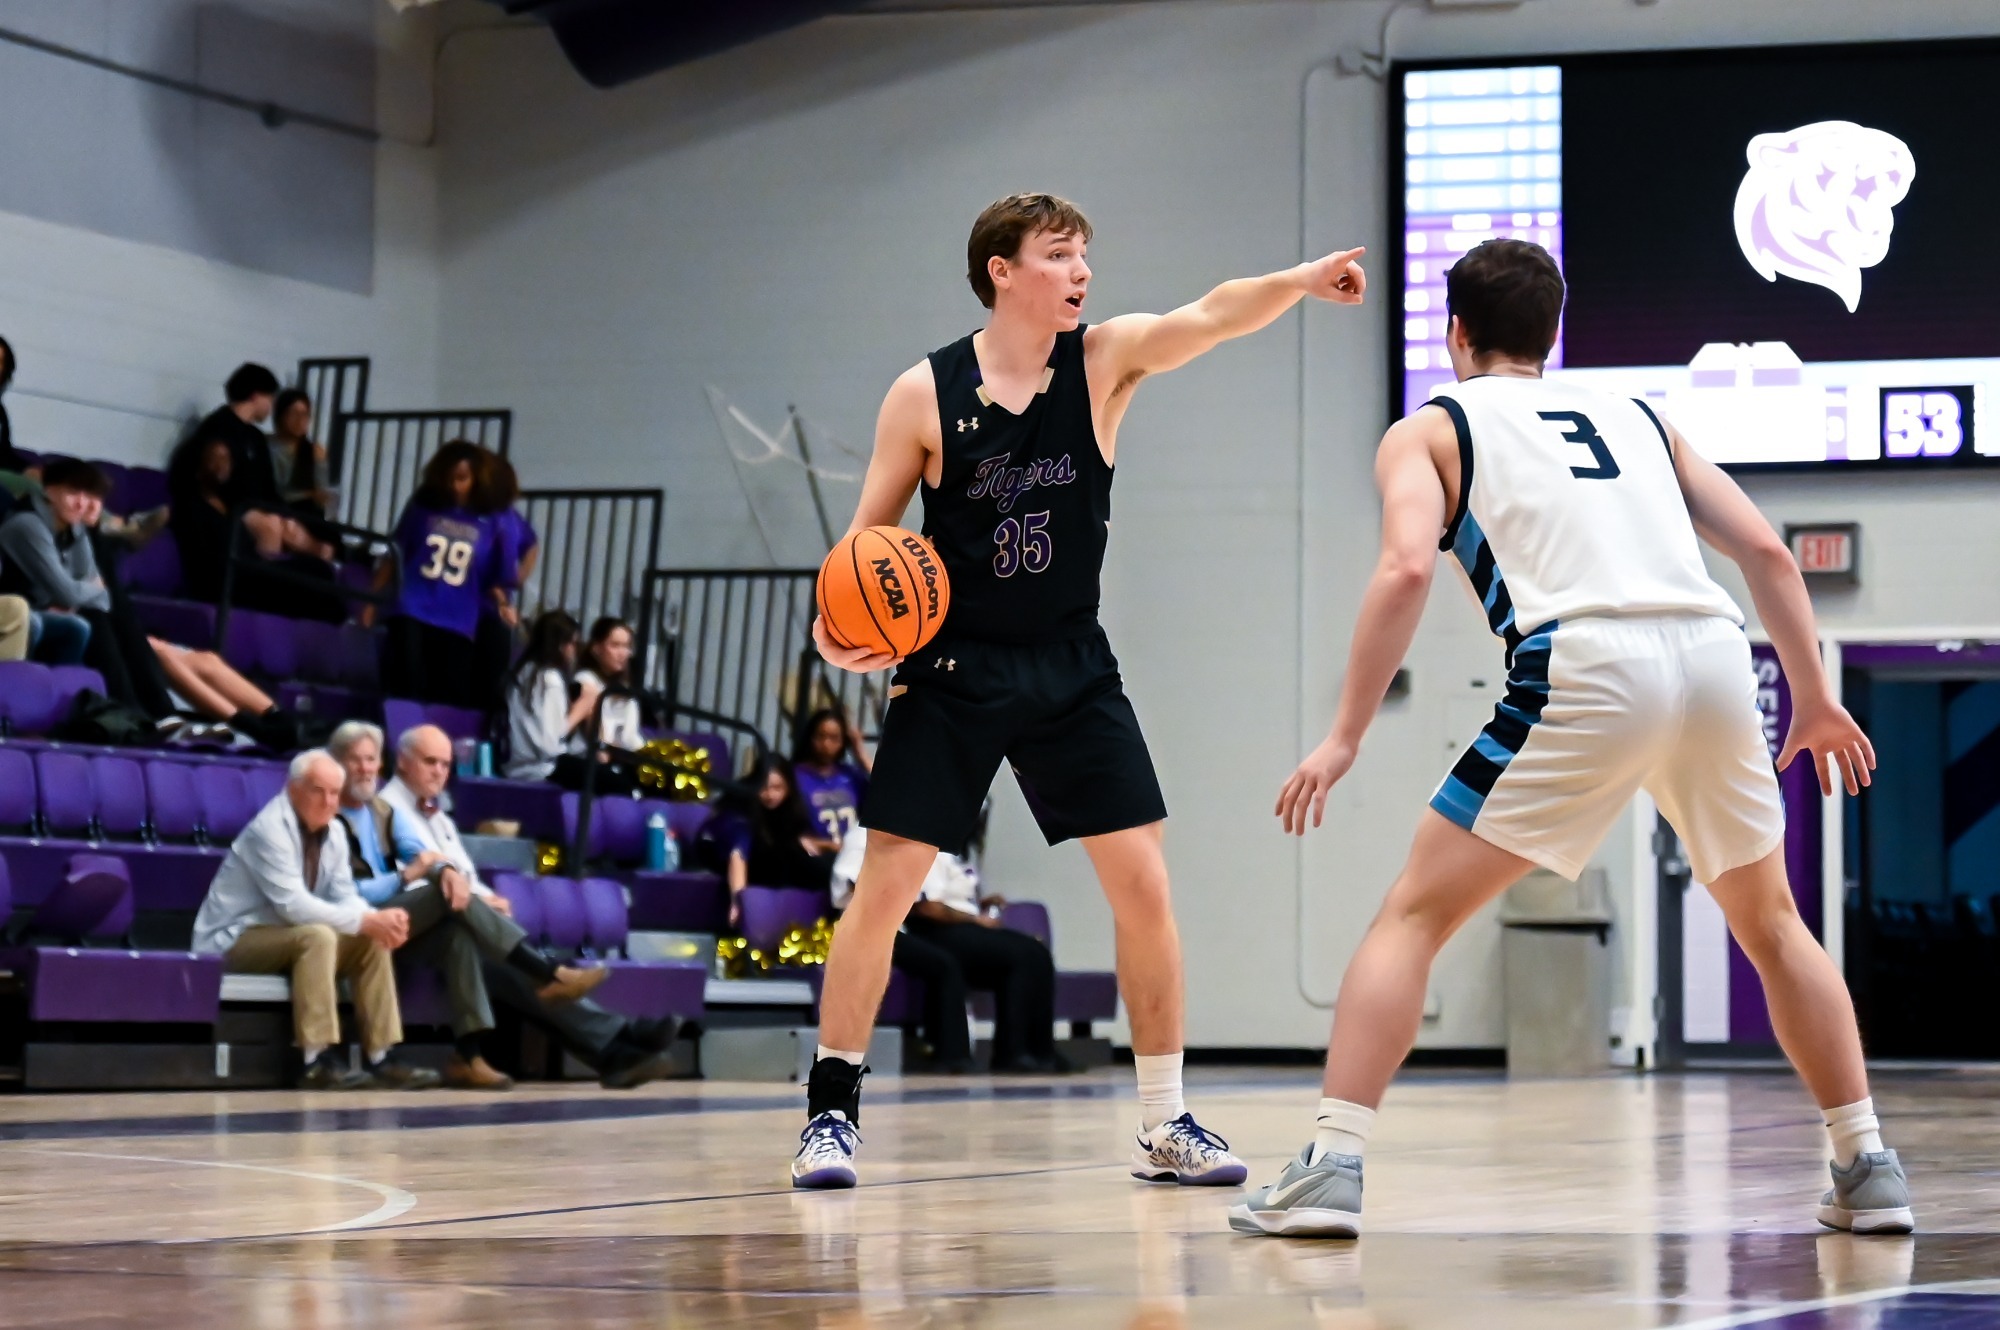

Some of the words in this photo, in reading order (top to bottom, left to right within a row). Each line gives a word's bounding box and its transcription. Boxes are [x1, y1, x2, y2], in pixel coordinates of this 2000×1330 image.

[1536, 410, 1621, 480] 3
[1884, 391, 1963, 458] 53
[967, 451, 1076, 513] Tigers
[421, 533, 473, 587] 39
[993, 509, 1052, 578] 35
[1801, 533, 1845, 570] EXIT
[871, 557, 910, 621] NCAA
[901, 535, 939, 621] Wilson
